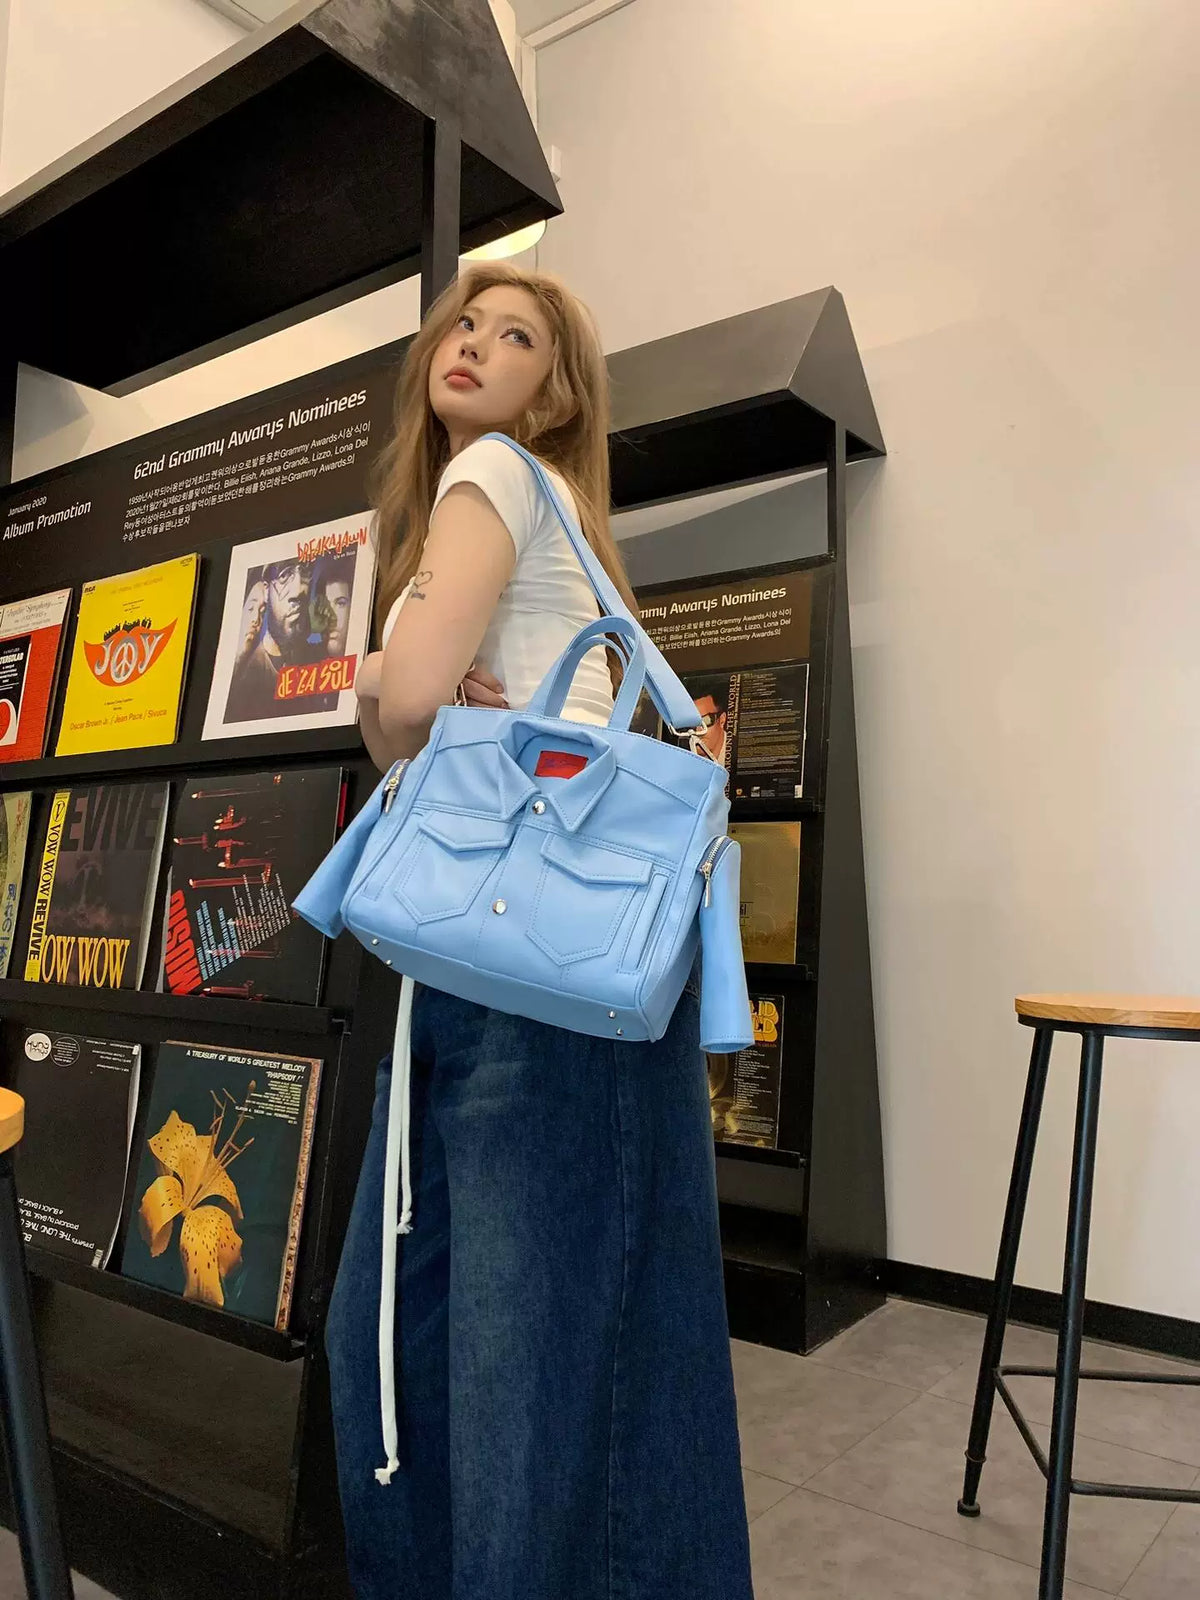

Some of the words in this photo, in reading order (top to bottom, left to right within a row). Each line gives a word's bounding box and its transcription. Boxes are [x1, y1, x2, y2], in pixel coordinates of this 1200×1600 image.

[134, 454, 165, 480] 62nd
[169, 438, 225, 469] Grammy
[228, 417, 285, 449] Awarys
[288, 388, 367, 429] Nominees
[2, 522, 34, 541] Album
[37, 499, 92, 531] Promotion
[8, 502, 32, 518] January
[670, 599, 718, 615] Awarys
[721, 586, 787, 607] Nominees
[728, 674, 737, 709] WORLD
[726, 710, 734, 730] THE
[725, 730, 734, 772] AROUND
[48, 824, 61, 856] VOW
[40, 860, 55, 896] WOW
[29, 899, 48, 961] REVIVE
[41, 935, 78, 985] OW
[78, 937, 130, 989] WOW
[192, 1050, 218, 1061] TREASURY
[252, 1058, 280, 1069] GREATEST
[282, 1061, 306, 1073] MELODY
[25, 1220, 40, 1231] TIME
[40, 1224, 58, 1236] LONG
[58, 1230, 71, 1240] THE
[71, 1237, 95, 1249] presents
